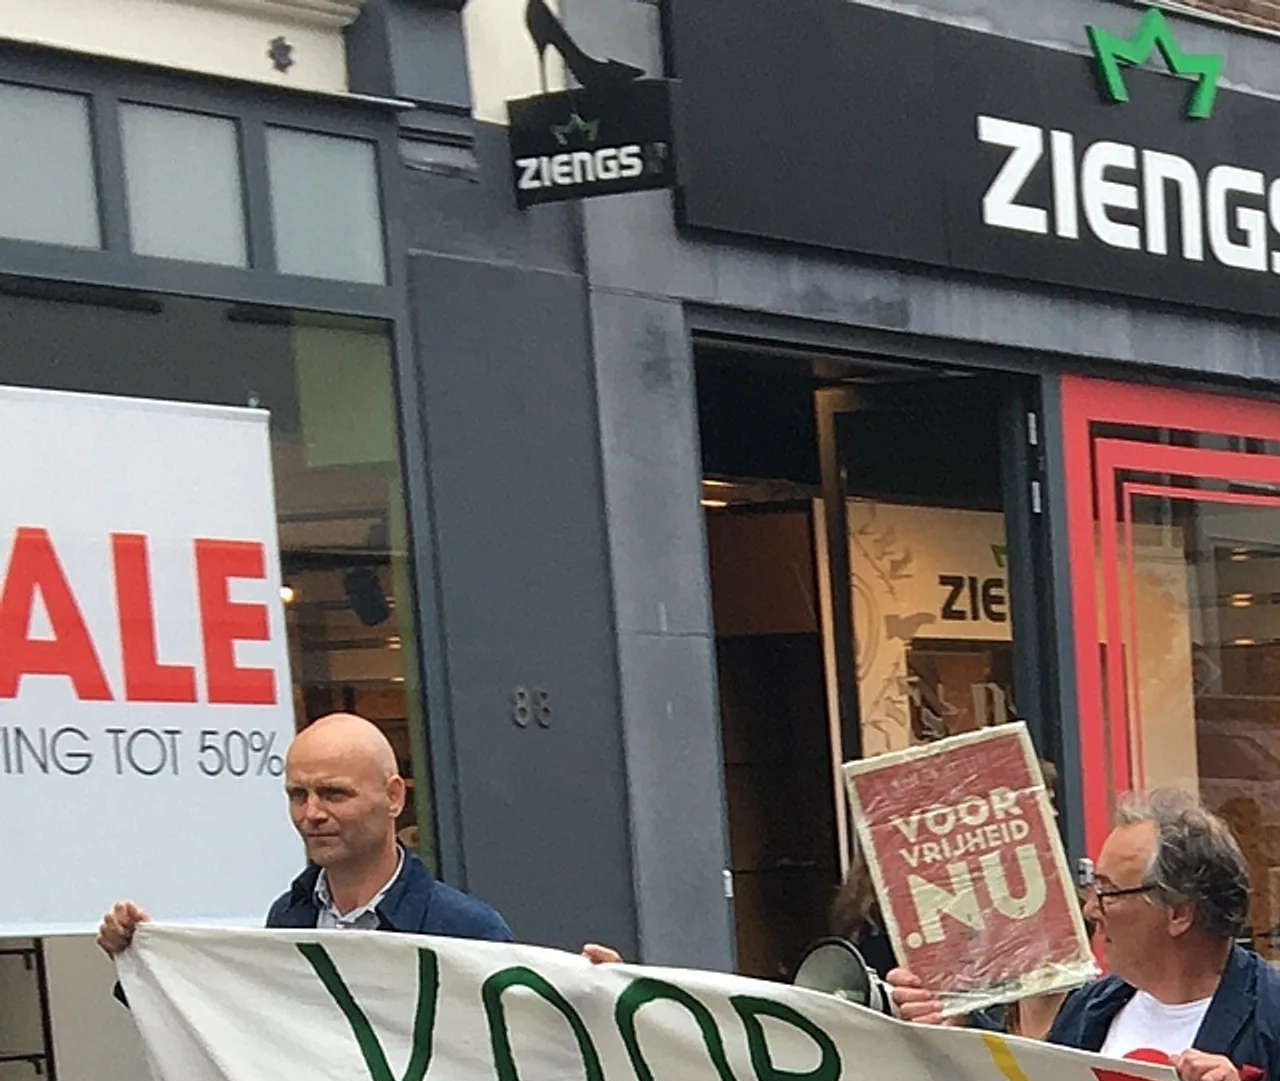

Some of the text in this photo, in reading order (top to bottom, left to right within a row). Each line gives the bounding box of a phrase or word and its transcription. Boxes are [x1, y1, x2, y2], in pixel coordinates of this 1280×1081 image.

[515, 145, 644, 190] ZIENGS
[105, 728, 182, 776] TOT
[198, 730, 284, 777] 50%
[890, 787, 1024, 843] VOOR
[899, 819, 1030, 868] VRIJHEID
